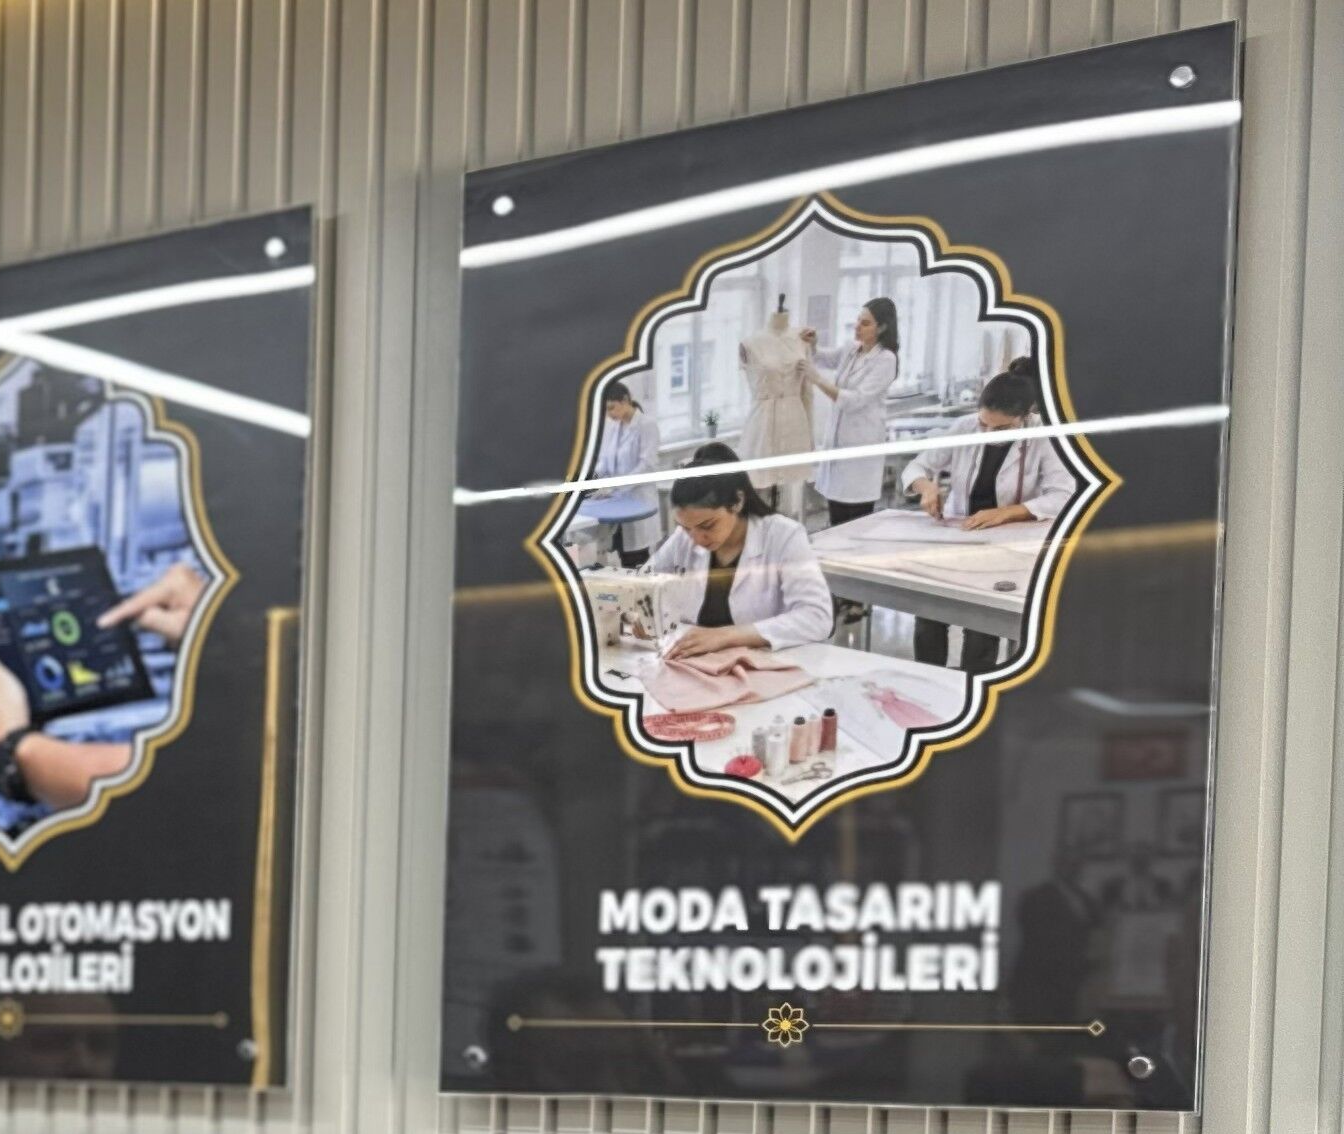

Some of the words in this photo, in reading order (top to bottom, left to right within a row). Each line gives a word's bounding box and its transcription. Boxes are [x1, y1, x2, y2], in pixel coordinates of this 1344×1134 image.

[17, 898, 231, 944] OTOMASYON
[598, 886, 749, 934] MODA
[758, 881, 1002, 933] TASARIM
[595, 932, 1000, 992] TEKNOLOJİLERİ
